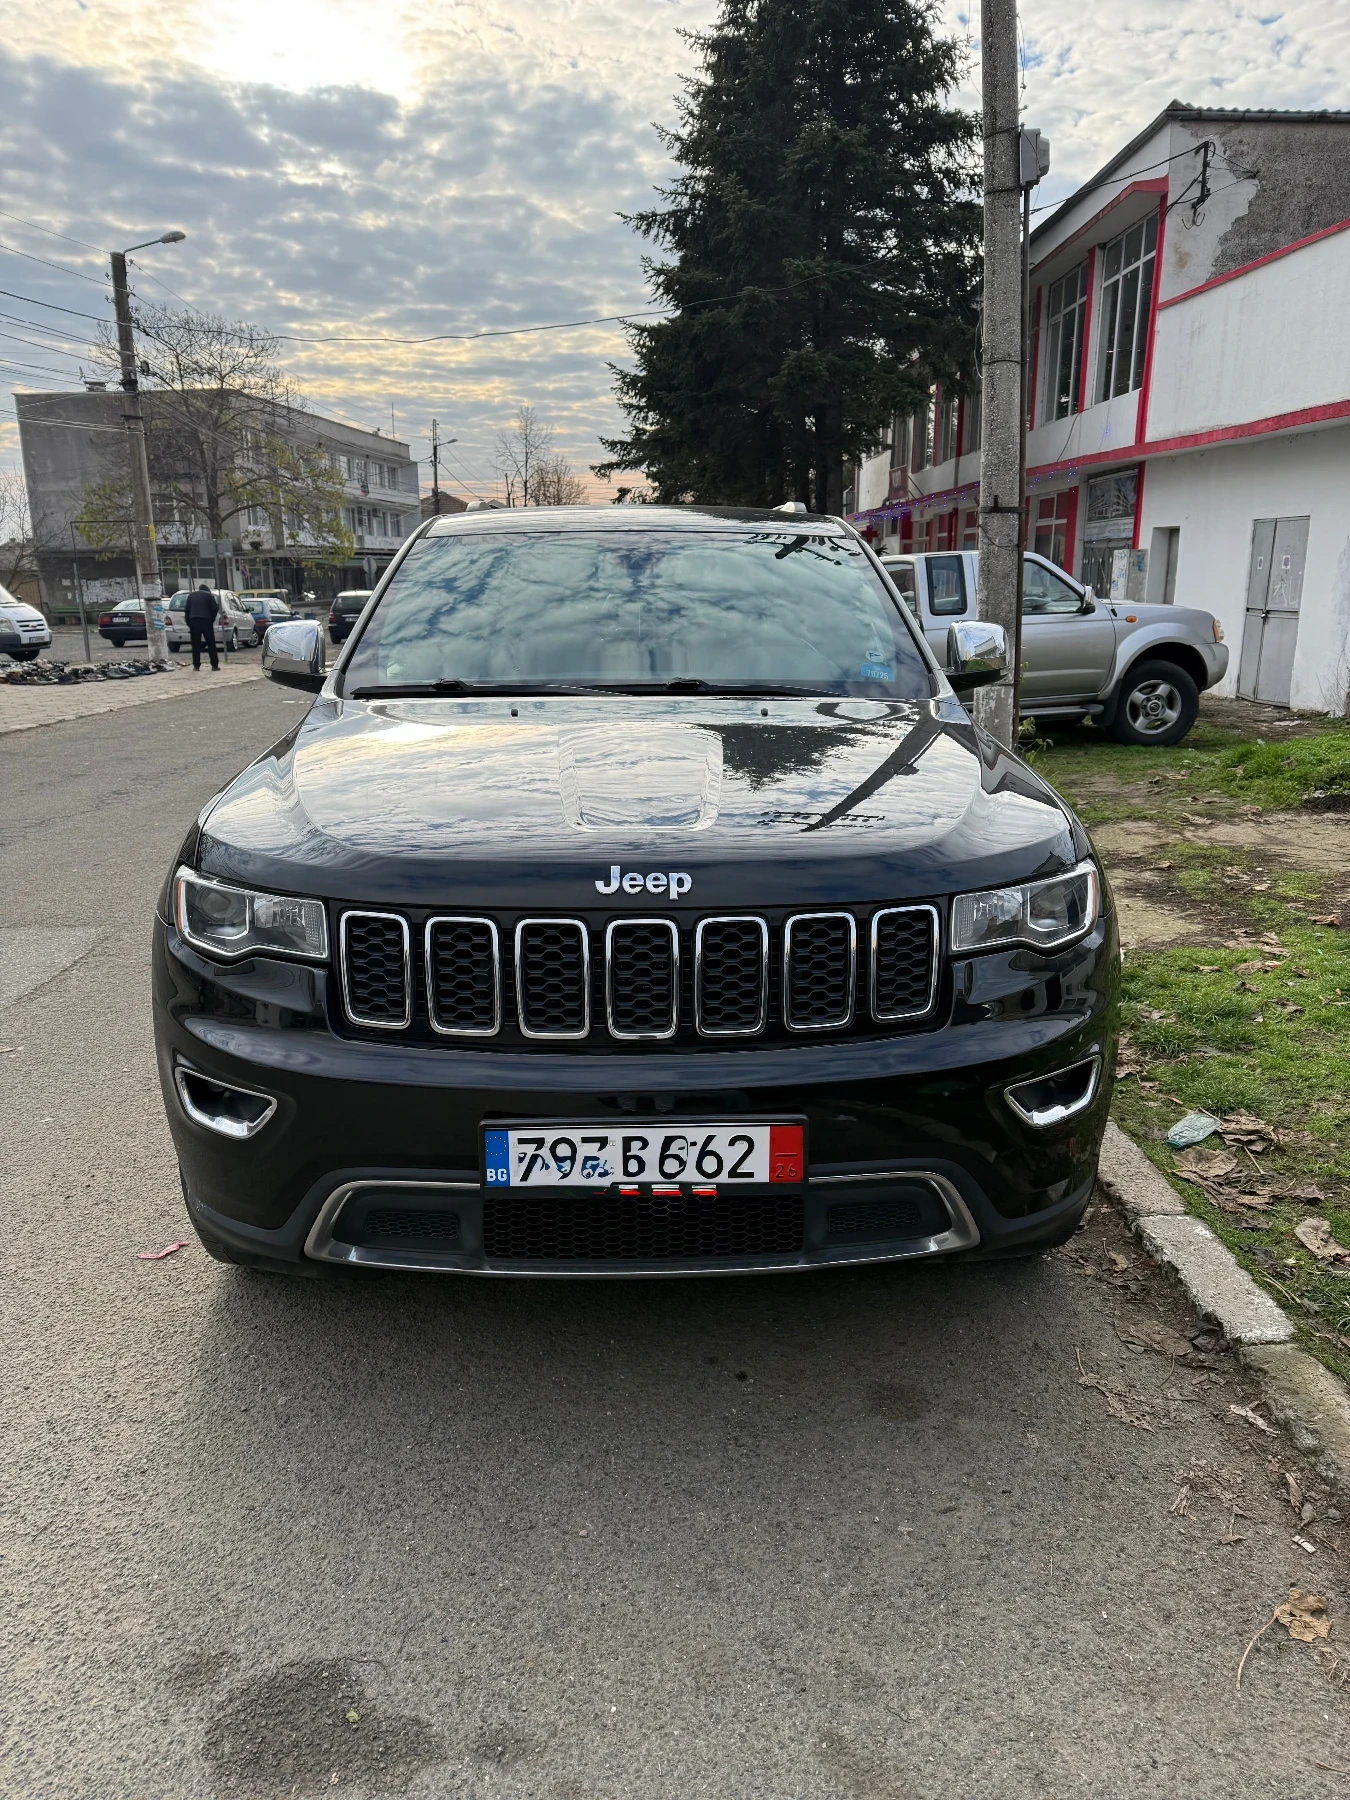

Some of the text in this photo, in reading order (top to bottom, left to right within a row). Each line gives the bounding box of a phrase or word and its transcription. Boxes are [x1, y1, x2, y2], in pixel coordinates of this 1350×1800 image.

[594, 865, 692, 900] Jeep
[486, 1168, 507, 1182] BG
[775, 1163, 798, 1179] 26
